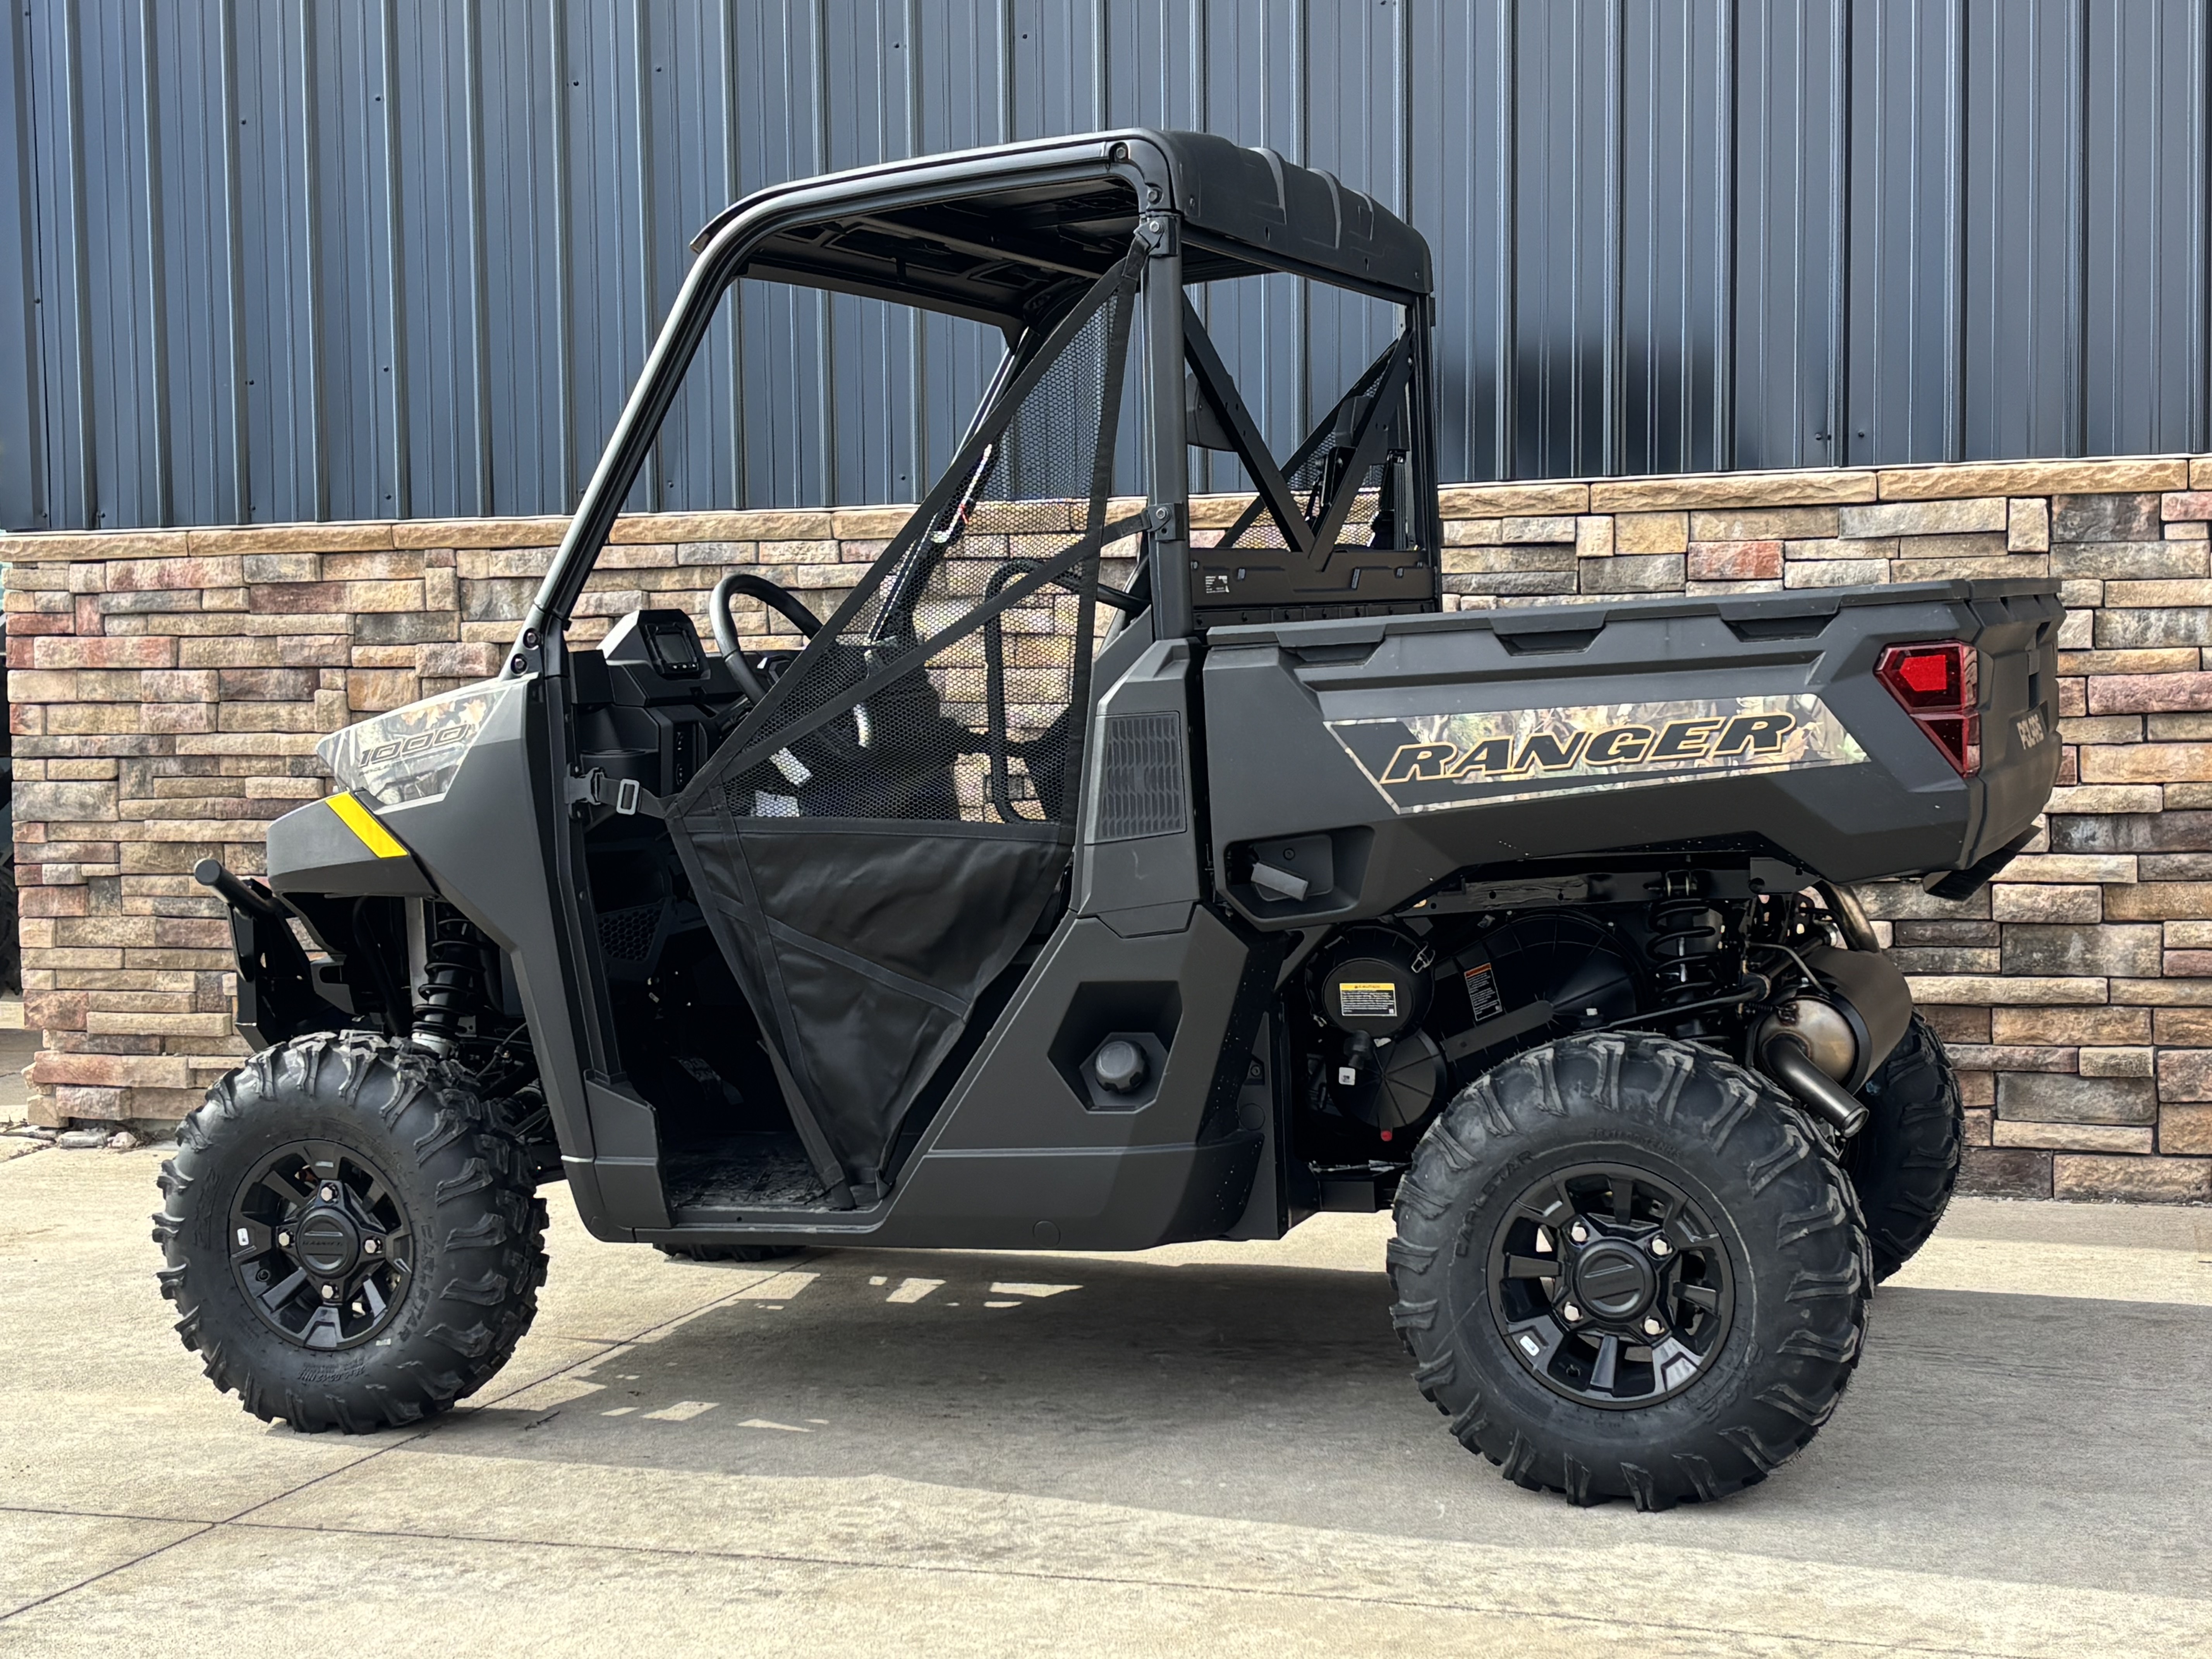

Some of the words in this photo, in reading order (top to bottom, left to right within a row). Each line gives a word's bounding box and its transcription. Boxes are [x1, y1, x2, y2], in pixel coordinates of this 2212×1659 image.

[358, 724, 470, 768] 1000
[1380, 713, 1797, 784] RANGER
[1455, 1150, 1534, 1257] CARLSTAR
[397, 1224, 435, 1342] CARLSTAR
